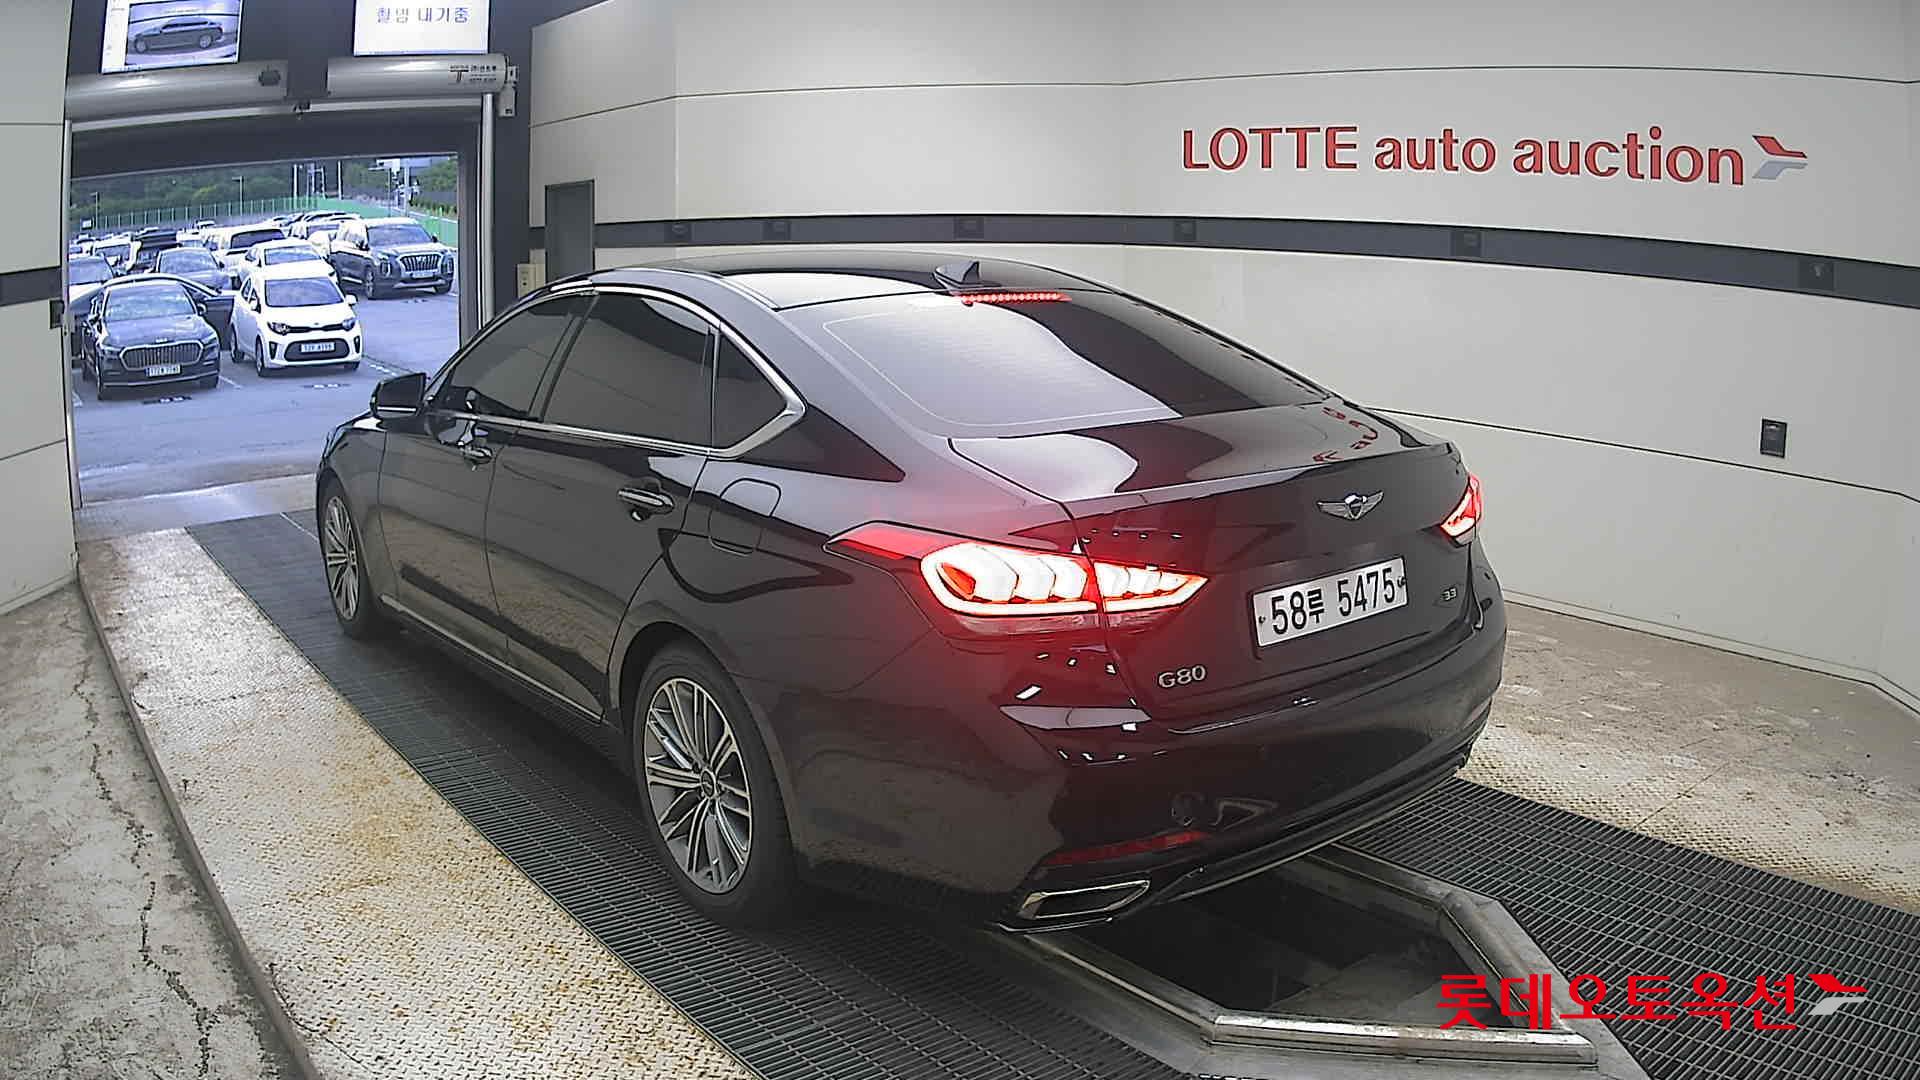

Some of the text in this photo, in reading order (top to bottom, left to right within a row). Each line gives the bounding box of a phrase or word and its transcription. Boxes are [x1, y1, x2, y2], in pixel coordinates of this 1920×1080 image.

[1184, 127, 1743, 185] LOTTE auto auction
[1271, 567, 1396, 635] 58루 5475
[1158, 665, 1206, 688] G80
